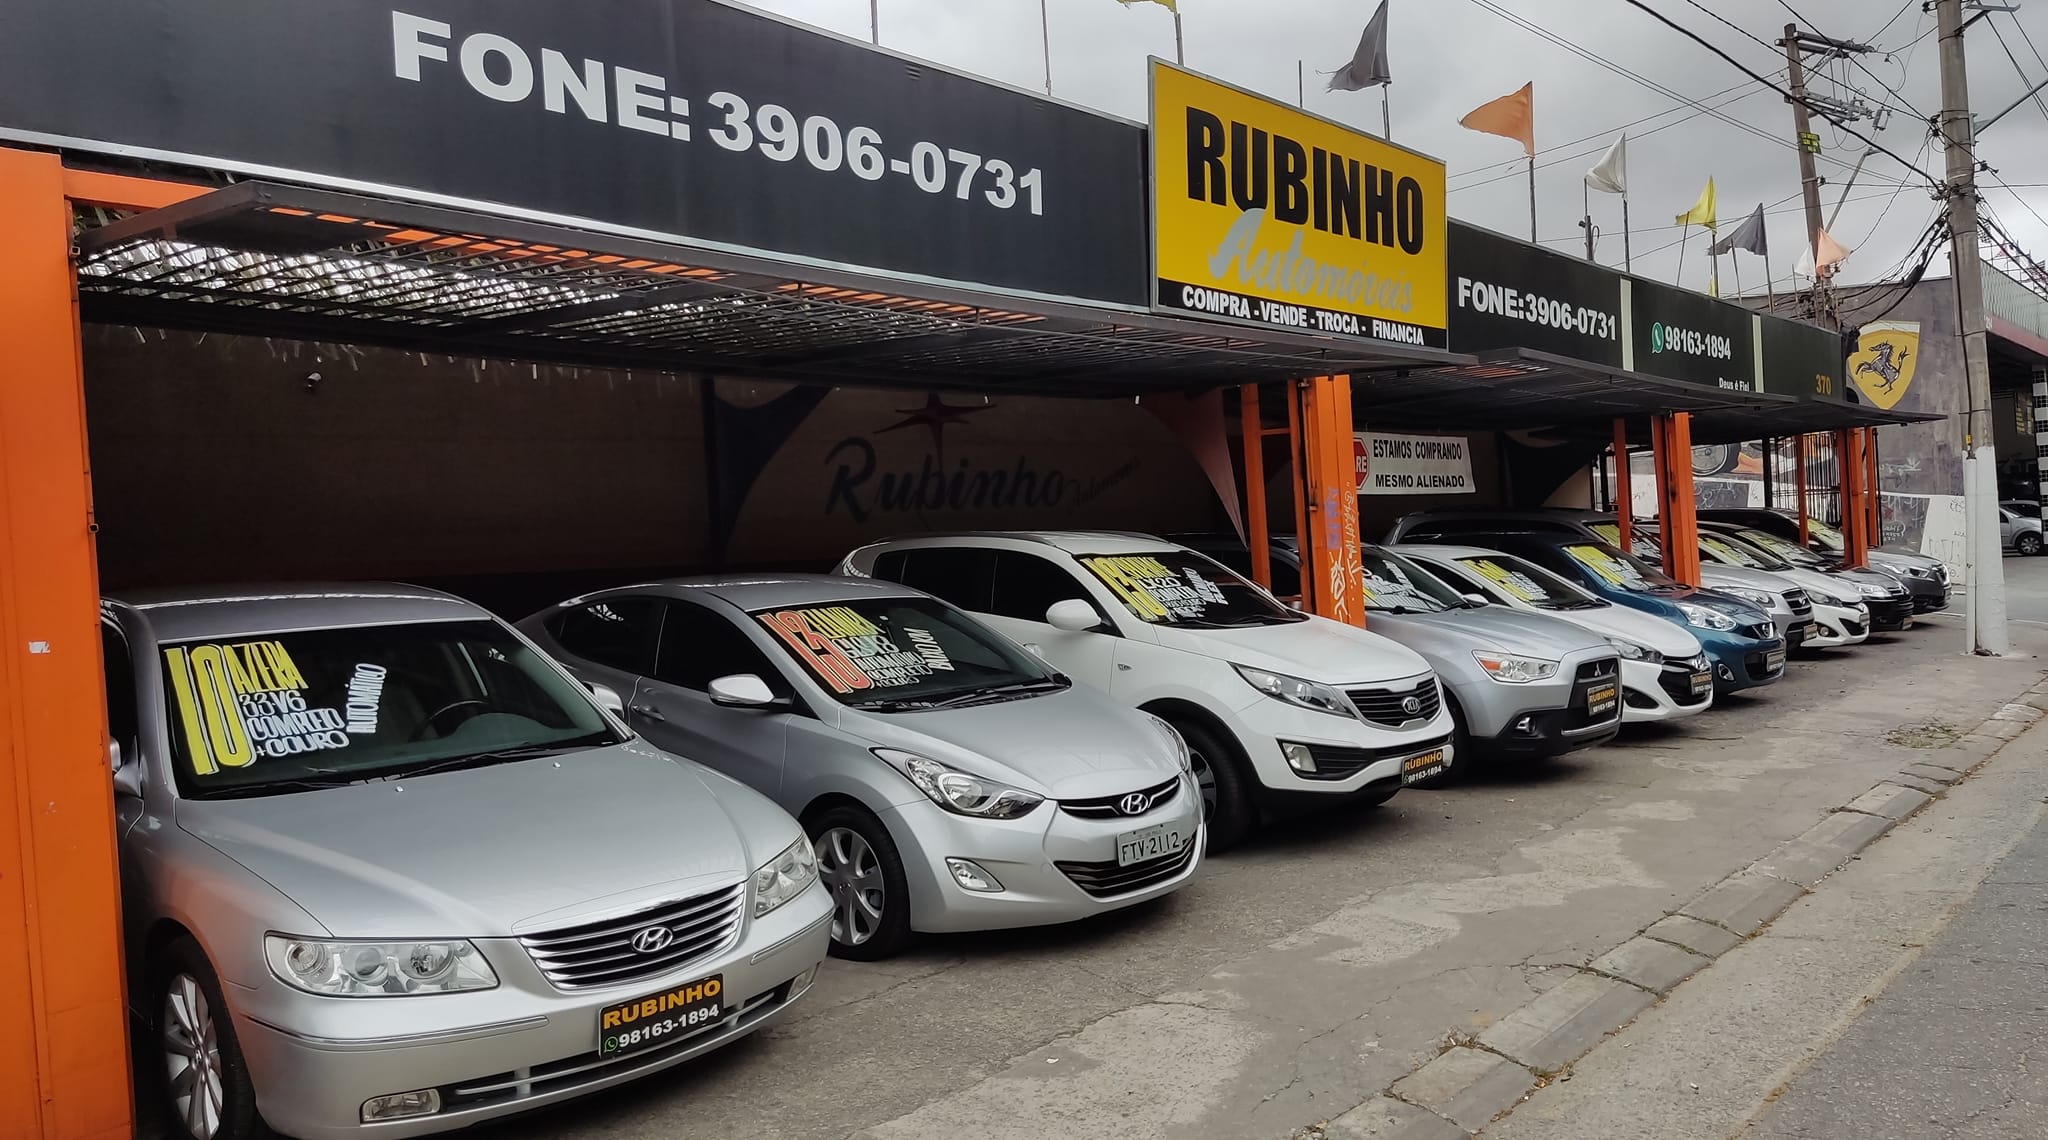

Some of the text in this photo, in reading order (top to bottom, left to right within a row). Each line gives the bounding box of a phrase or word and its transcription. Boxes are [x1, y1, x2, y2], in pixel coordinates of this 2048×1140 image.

[392, 11, 1043, 216] FONE: 3906-0731
[1186, 105, 1423, 255] RUBINHO
[1182, 285, 1251, 319] COMPRA
[1260, 301, 1308, 328] VENDE
[1316, 310, 1360, 335] TROCA
[1372, 319, 1424, 346] FINANCIA
[1665, 325, 1731, 360] 98163-1894
[1719, 377, 1734, 390] Deus
[1739, 380, 1750, 392] Fiel
[1815, 374, 1832, 395] 370
[1373, 439, 1462, 461] ESTAMOS COMPRANDO
[824, 436, 1065, 523] Rubinho
[1375, 474, 1464, 488] MESMO ALIENADO
[223, 640, 309, 694] AZERA
[757, 610, 876, 694] 13
[164, 644, 257, 775] 10
[246, 708, 346, 741] COMPLETO
[1404, 751, 1443, 771] RUBINHO
[603, 979, 721, 1029] RUBINHO
[618, 1004, 719, 1047] 98163-1894
